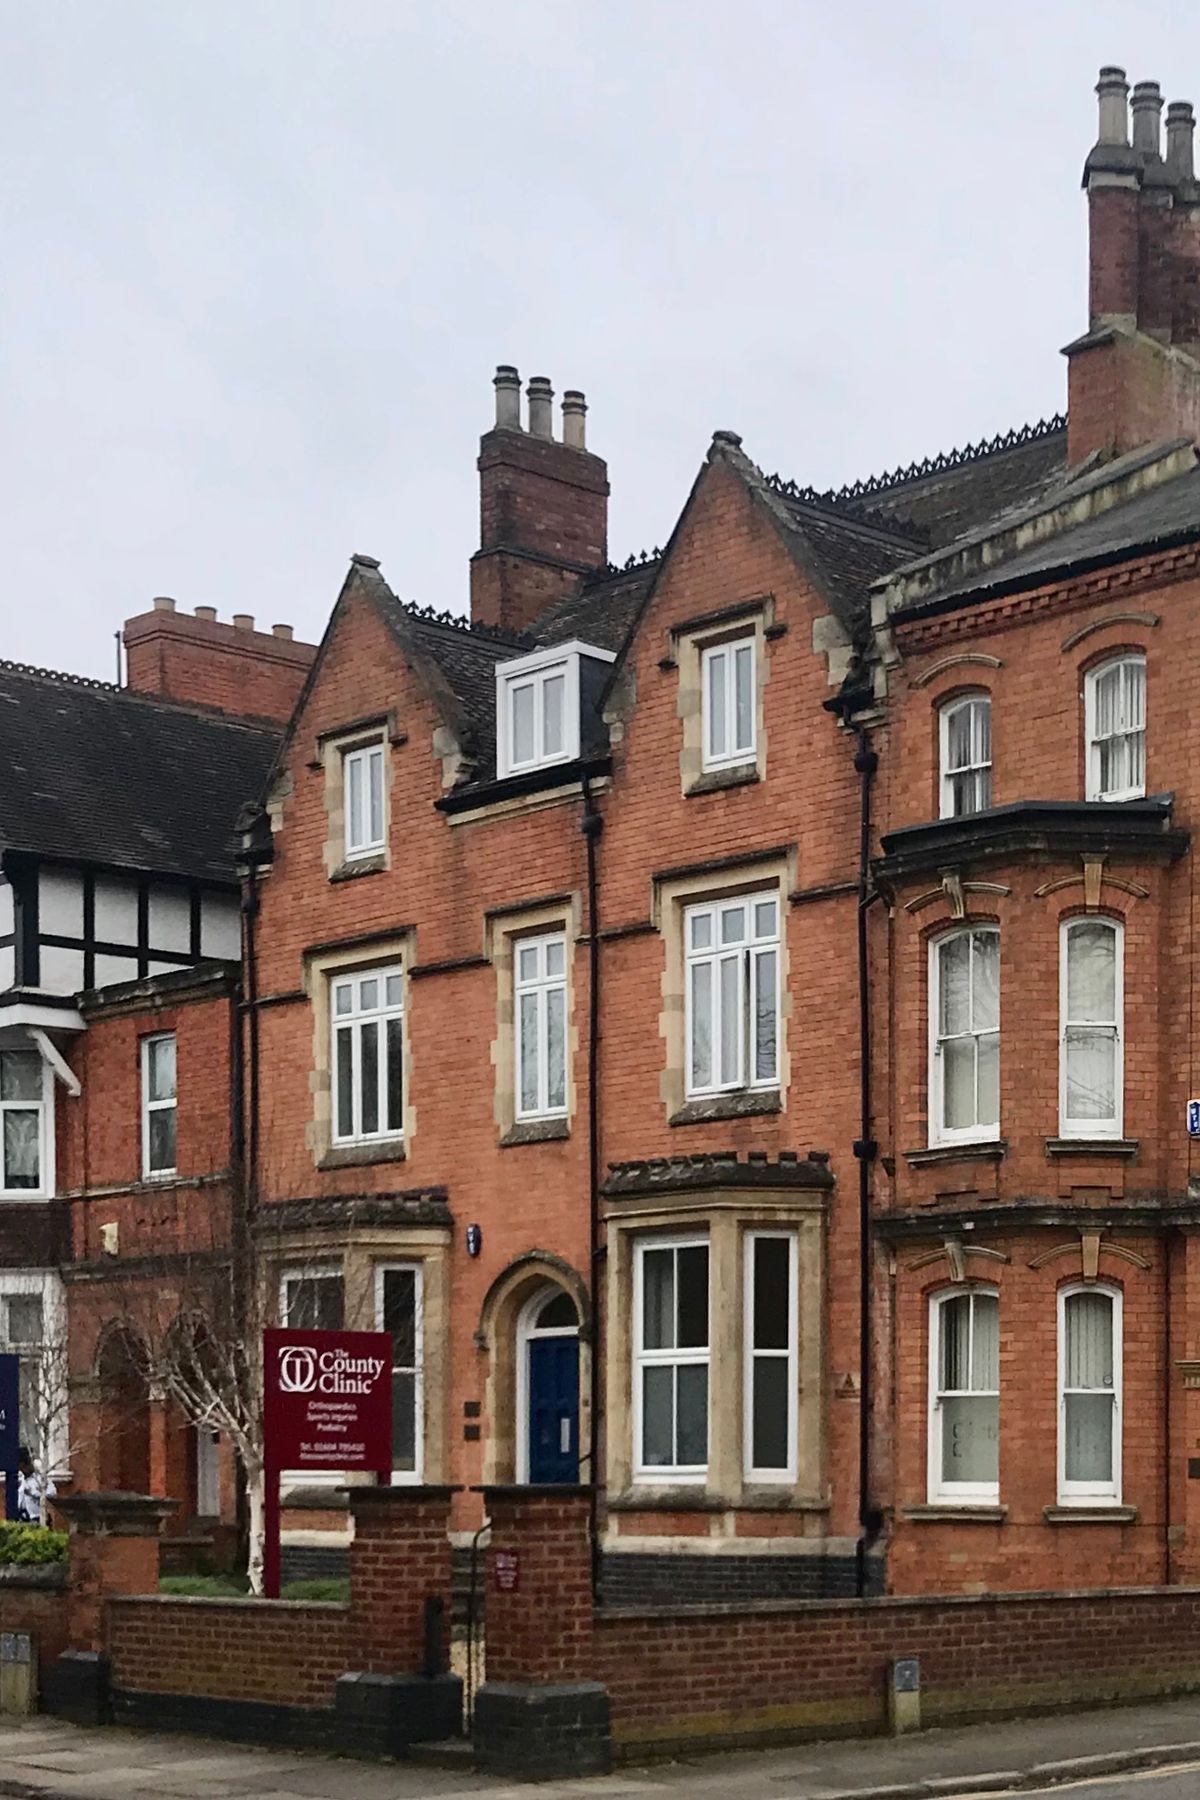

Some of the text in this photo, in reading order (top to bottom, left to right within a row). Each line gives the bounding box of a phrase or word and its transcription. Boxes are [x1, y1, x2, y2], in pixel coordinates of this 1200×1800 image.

[335, 1349, 349, 1358] The
[319, 1352, 385, 1380] County
[319, 1373, 373, 1394] Clinic
[307, 1412, 330, 1421] Sports
